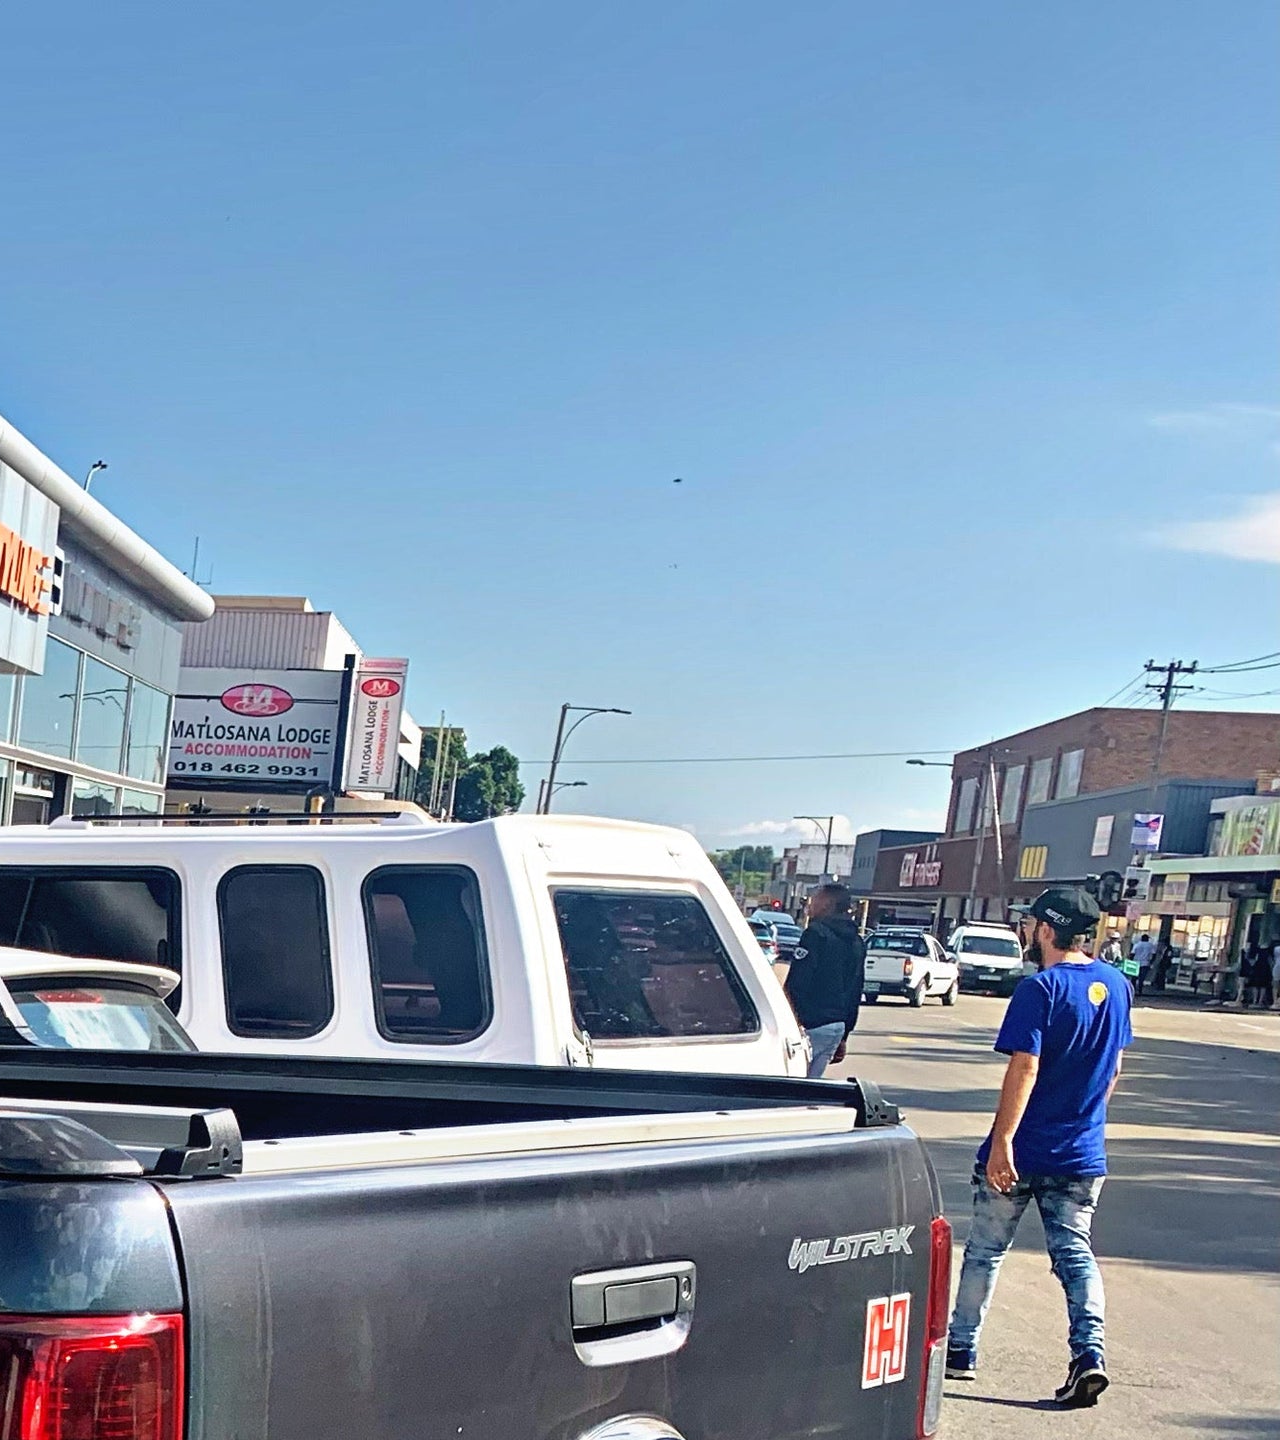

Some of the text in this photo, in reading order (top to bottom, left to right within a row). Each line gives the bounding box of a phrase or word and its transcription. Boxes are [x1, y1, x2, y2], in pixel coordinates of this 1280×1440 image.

[372, 680, 390, 691] M
[365, 700, 378, 728] LODGE
[277, 723, 331, 745] LODGE
[375, 709, 390, 777] ACCOMMODATION
[184, 742, 312, 759] ACCOMMODATION
[174, 761, 319, 777] 018 462 9931
[787, 1225, 916, 1274] WILDTRAK
[861, 1292, 912, 1390] H
